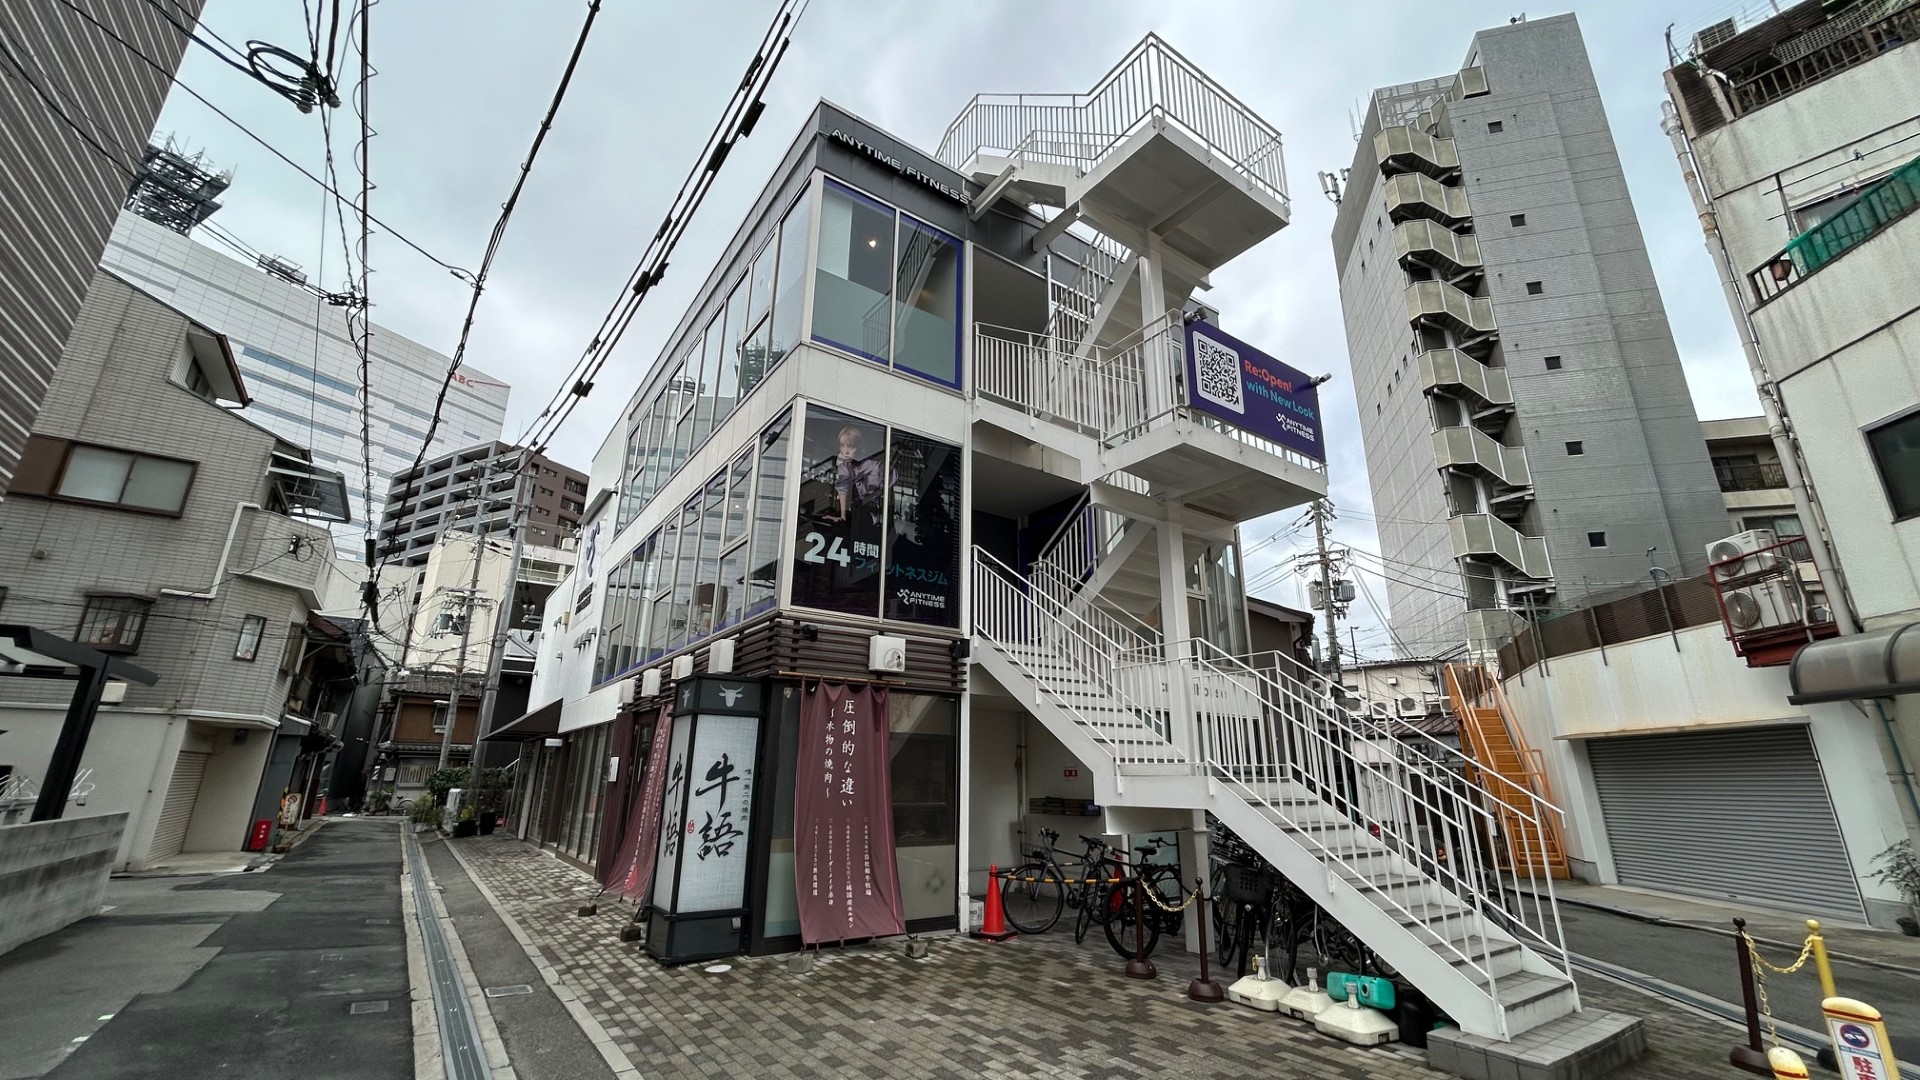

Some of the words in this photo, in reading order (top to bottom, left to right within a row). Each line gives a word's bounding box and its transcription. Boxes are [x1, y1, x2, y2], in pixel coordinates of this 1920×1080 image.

[831, 128, 901, 170] ANYTIME
[906, 166, 970, 205] FITNESS
[451, 371, 475, 388] ABC
[1244, 359, 1293, 393] Re:Open!
[1246, 381, 1269, 398] with
[1270, 392, 1293, 410] New
[1293, 401, 1315, 420] Look
[1286, 426, 1315, 442] FITNESS
[1287, 418, 1314, 435] ANYTIME
[909, 591, 945, 602] ANYTIME
[909, 598, 945, 609] FITNESS
[840, 699, 856, 807] 圧倒的な違い
